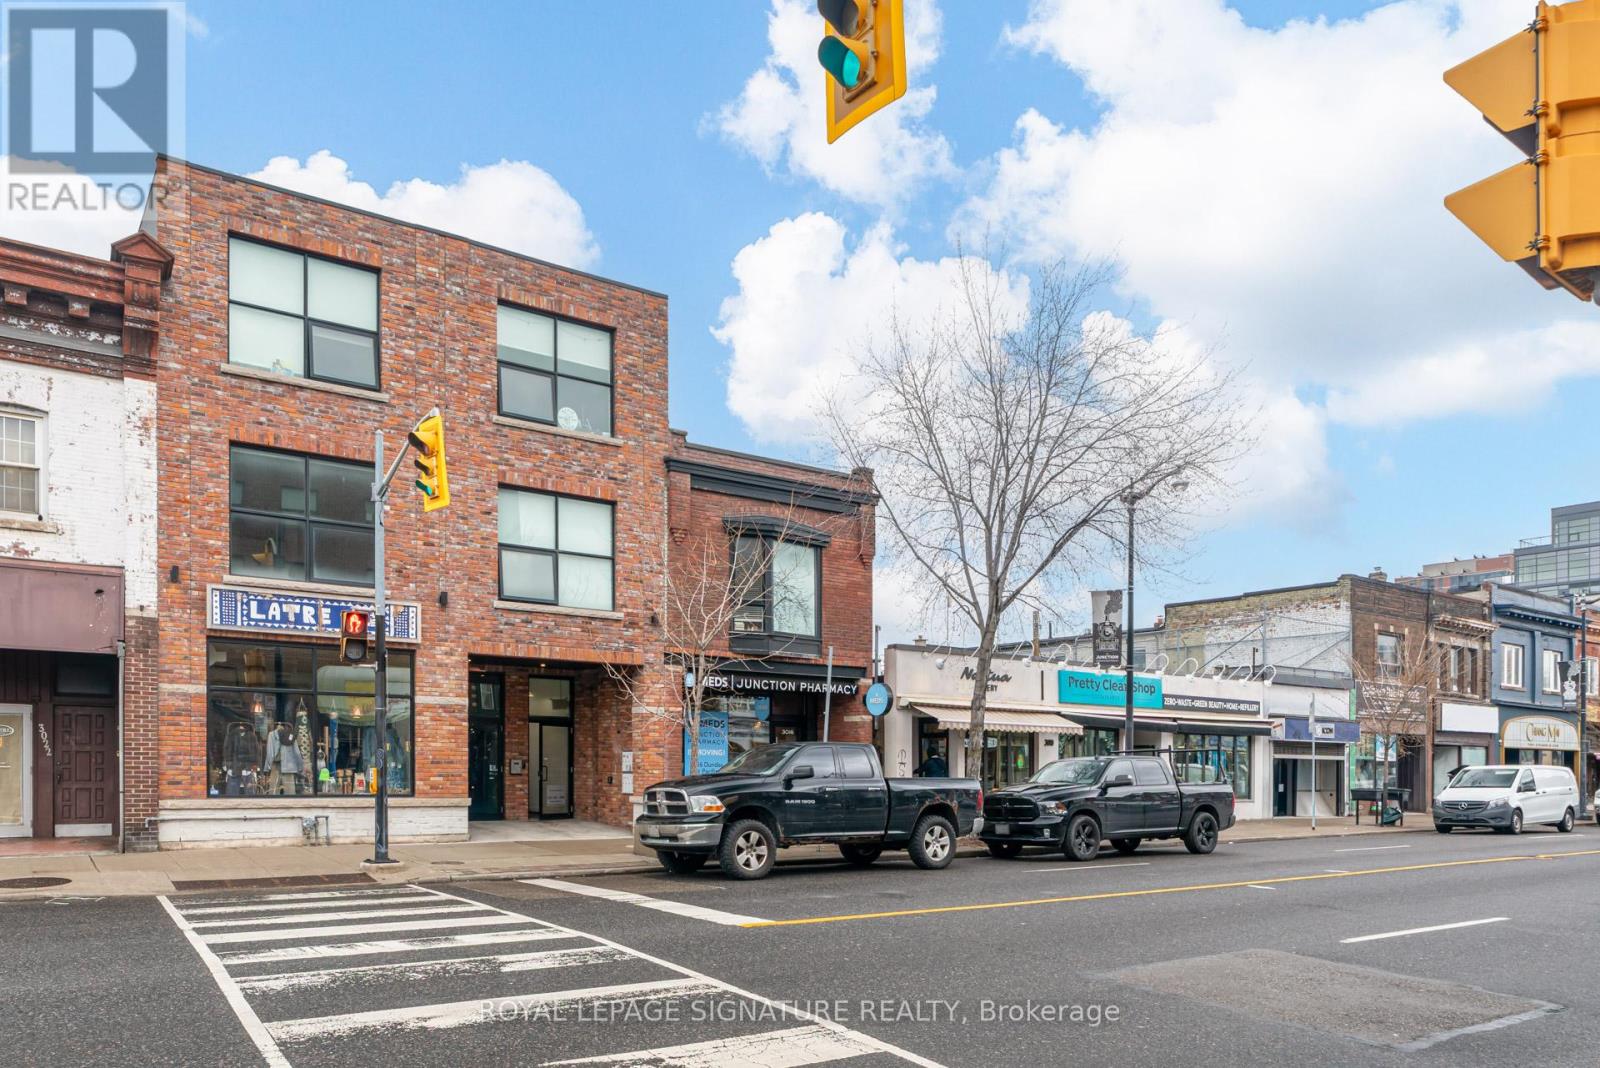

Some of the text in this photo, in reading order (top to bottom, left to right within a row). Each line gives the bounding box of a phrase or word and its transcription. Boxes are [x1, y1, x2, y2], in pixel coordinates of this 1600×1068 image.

[250, 600, 332, 625] LATRE
[736, 679, 796, 692] JUNCTION
[800, 681, 858, 695] PHARMACY
[1068, 675, 1101, 692] Pretty
[1133, 681, 1156, 696] Shop
[38, 723, 53, 757] 3022
